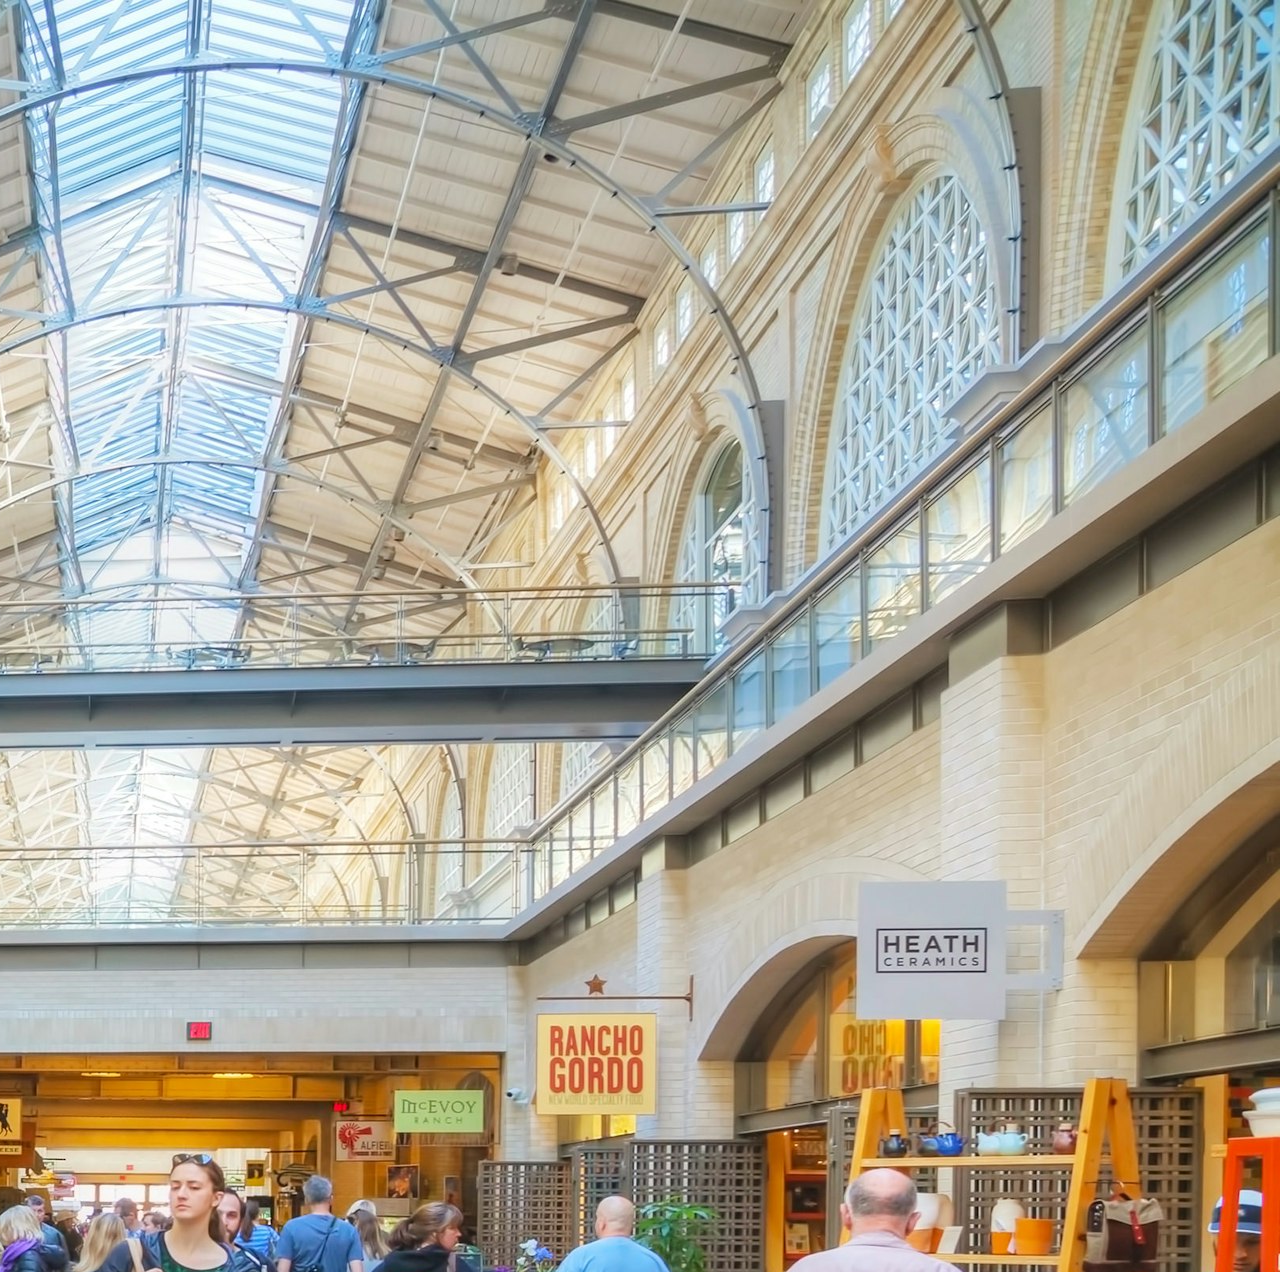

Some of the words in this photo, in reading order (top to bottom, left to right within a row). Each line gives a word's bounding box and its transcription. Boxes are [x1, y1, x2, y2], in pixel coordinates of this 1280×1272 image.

[884, 935, 979, 953] HEATH
[884, 957, 979, 967] CERAMICS
[550, 1025, 643, 1056] RANCHO
[549, 1057, 643, 1094] GORDO
[401, 1099, 477, 1114] McEVOY
[549, 1095, 562, 1105] NEW
[565, 1095, 588, 1105] WORLD
[589, 1094, 624, 1105] SPECIALTY
[625, 1094, 644, 1105] FOOD
